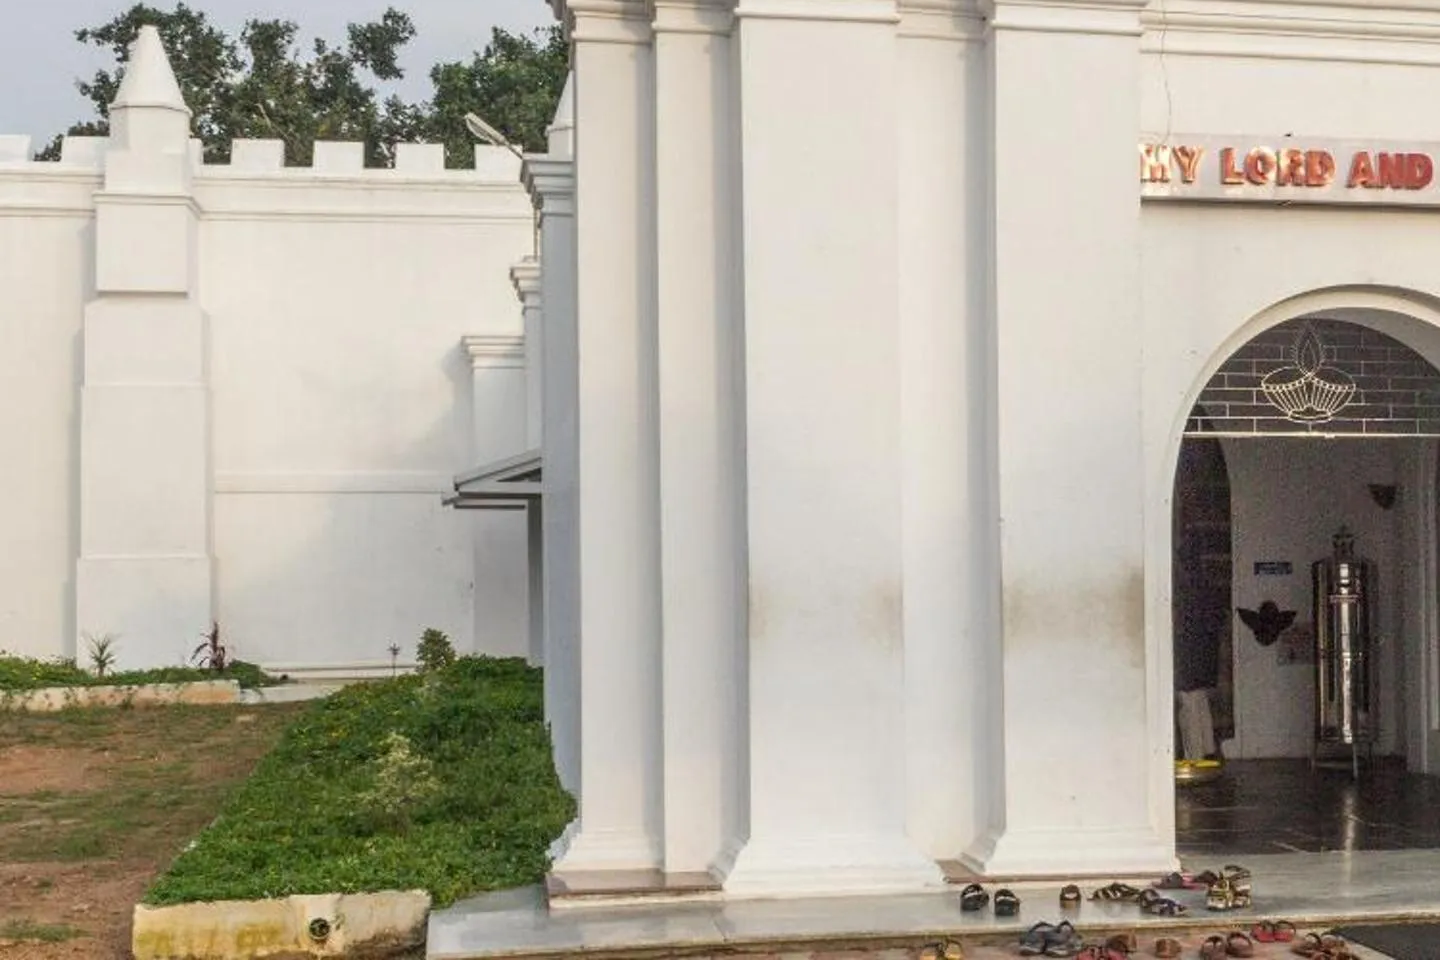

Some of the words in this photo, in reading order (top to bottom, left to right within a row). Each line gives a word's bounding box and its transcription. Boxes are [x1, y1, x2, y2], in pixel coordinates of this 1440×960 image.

[1139, 143, 1204, 184] MY
[1220, 146, 1336, 187] LORD
[1346, 151, 1433, 190] AND
